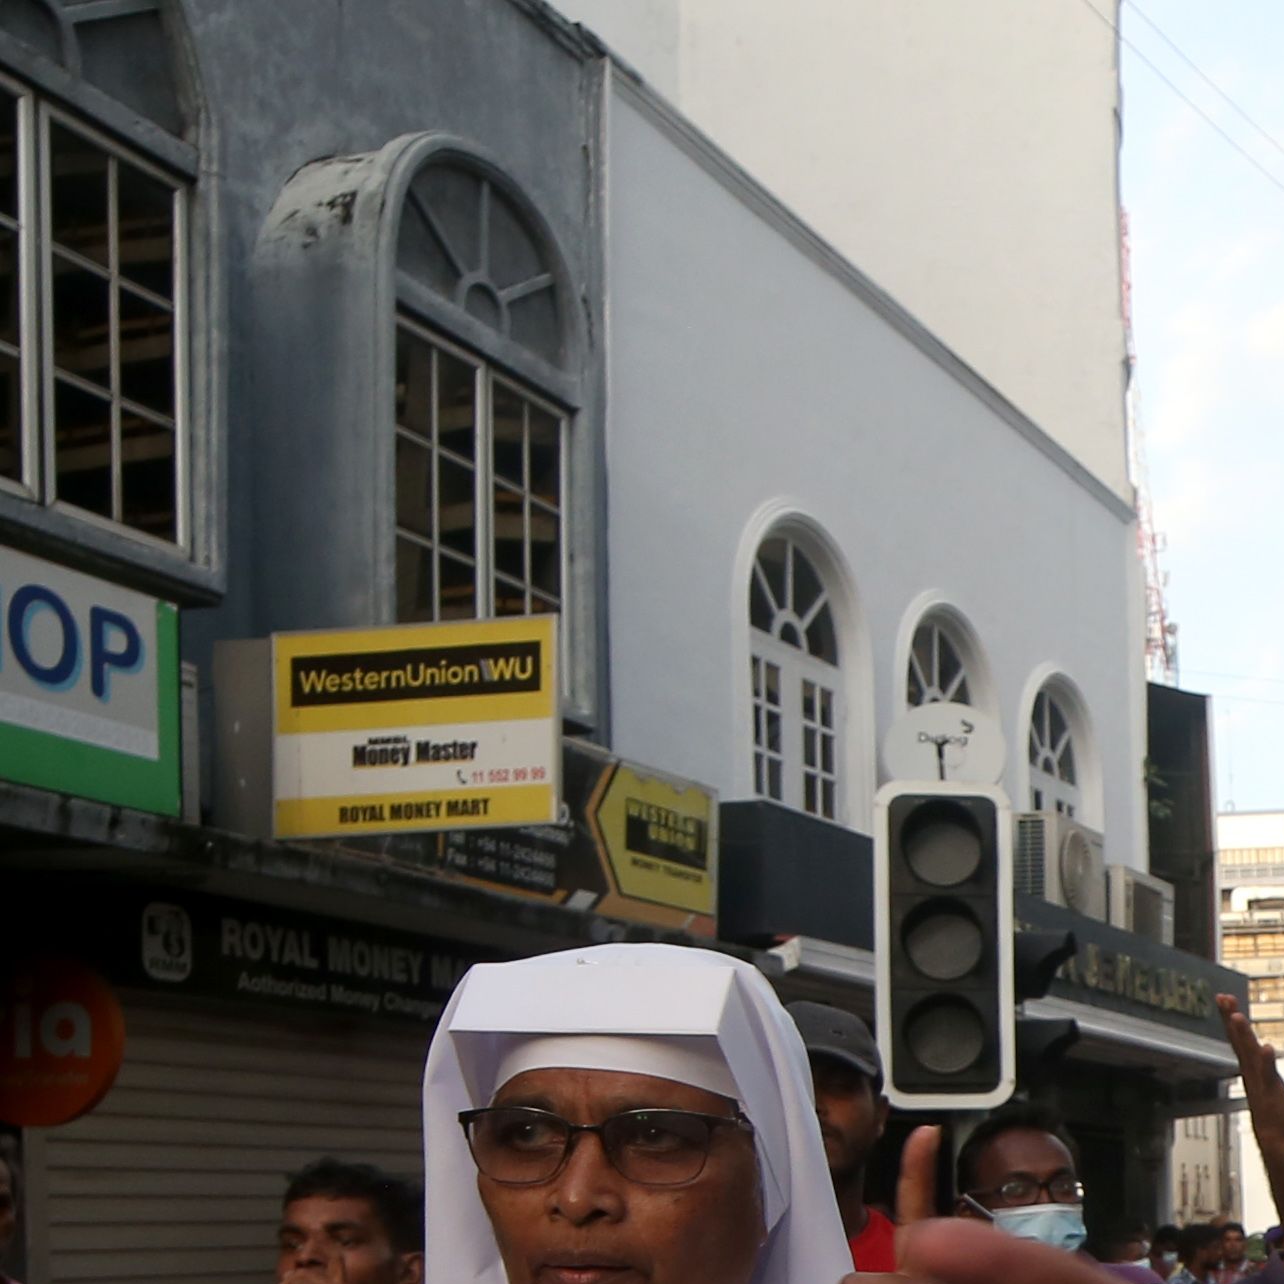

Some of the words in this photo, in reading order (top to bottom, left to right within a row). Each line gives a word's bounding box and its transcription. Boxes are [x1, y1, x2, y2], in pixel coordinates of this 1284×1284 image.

[0, 584, 141, 700] OP
[300, 659, 478, 694] WesternUnion
[353, 743, 410, 767] Money
[416, 740, 478, 763] Master
[472, 771, 484, 783] 11
[339, 804, 385, 824] ROYAL
[390, 801, 443, 821] MONEY
[446, 797, 491, 818] MART
[221, 918, 318, 969] ROYAL
[328, 935, 424, 986] MONEY
[431, 953, 471, 989] MA
[0, 976, 92, 1058] ia
